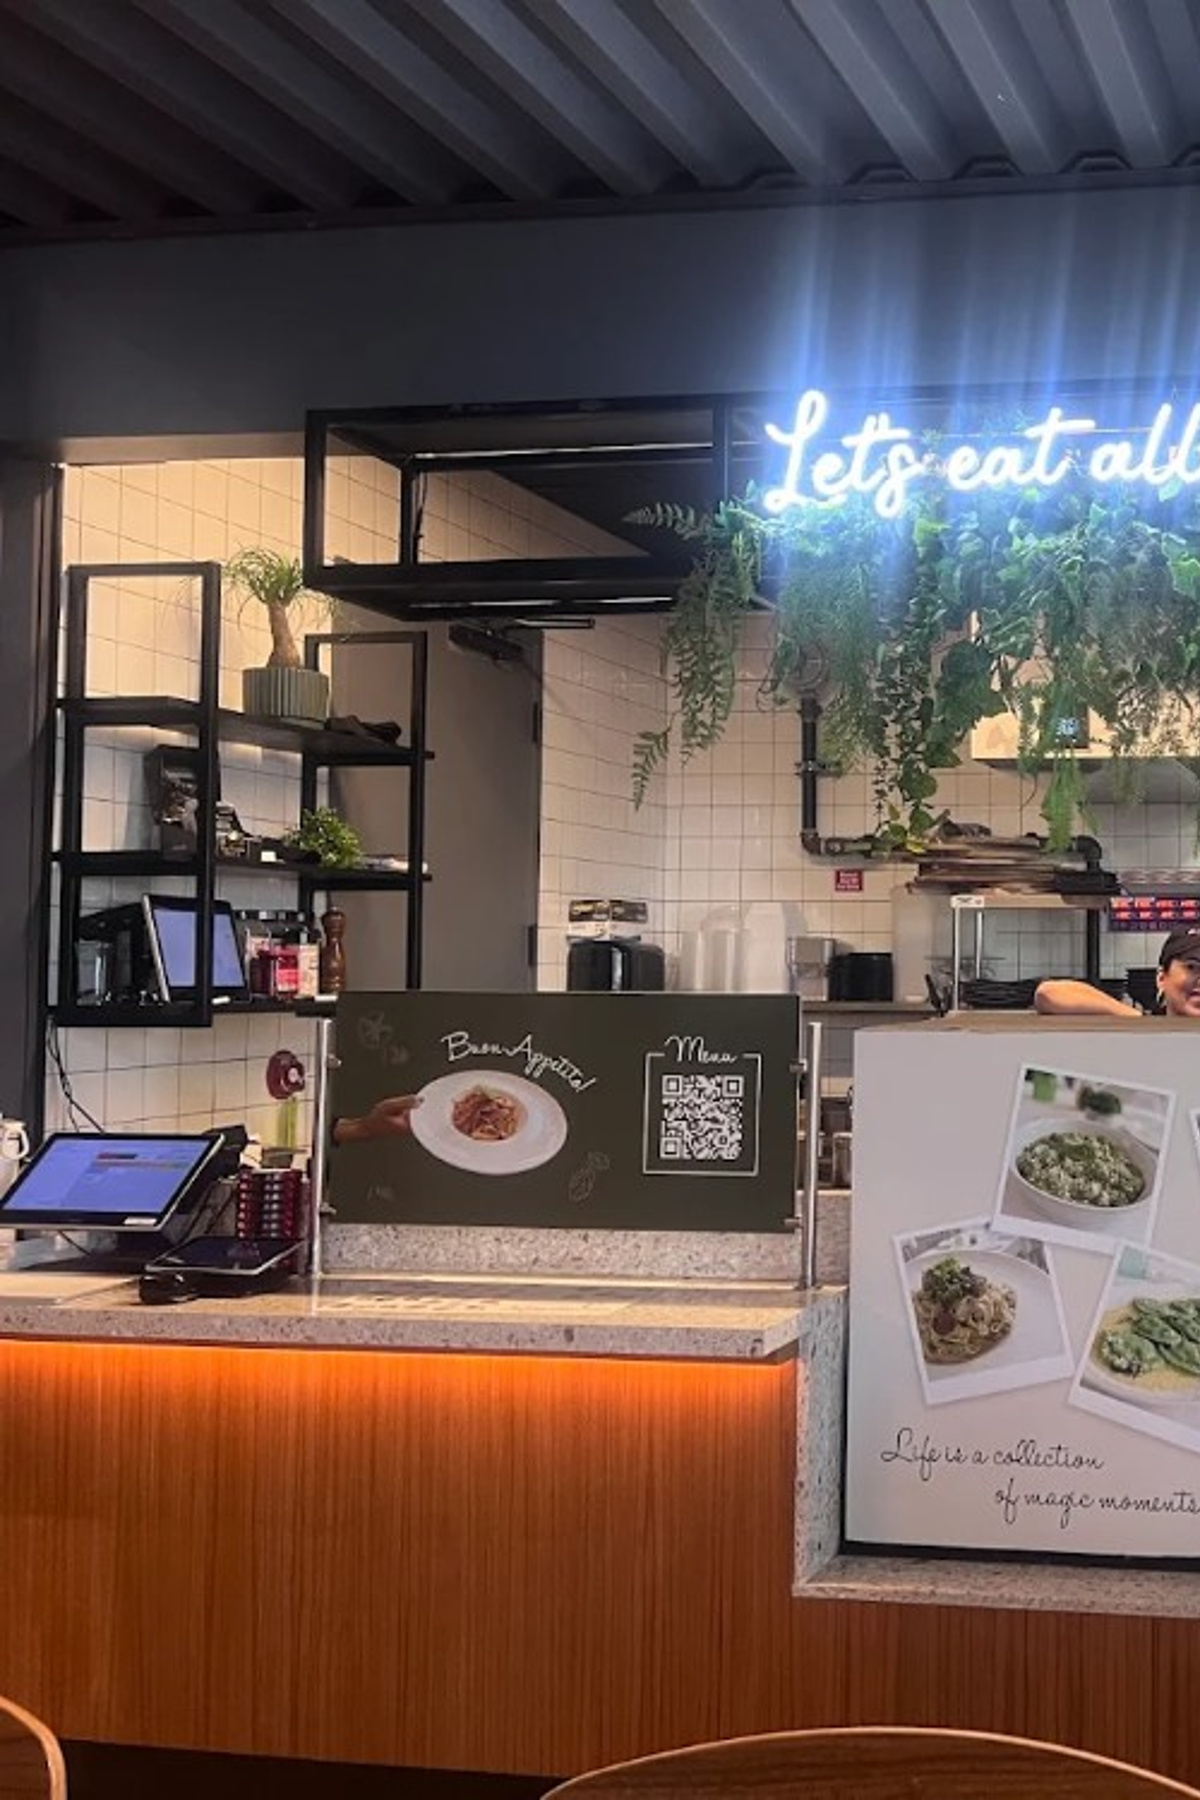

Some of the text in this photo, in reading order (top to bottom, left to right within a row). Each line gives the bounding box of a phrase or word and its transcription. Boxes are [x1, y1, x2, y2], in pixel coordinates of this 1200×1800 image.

[763, 389, 922, 518] Let's
[946, 406, 1096, 490] eat
[440, 1030, 597, 1093] Buon Appetito!
[664, 1035, 738, 1064] Menu
[880, 1427, 1106, 1482] Life is a collection
[994, 1477, 1022, 1525] of
[1023, 1491, 1095, 1530] magic
